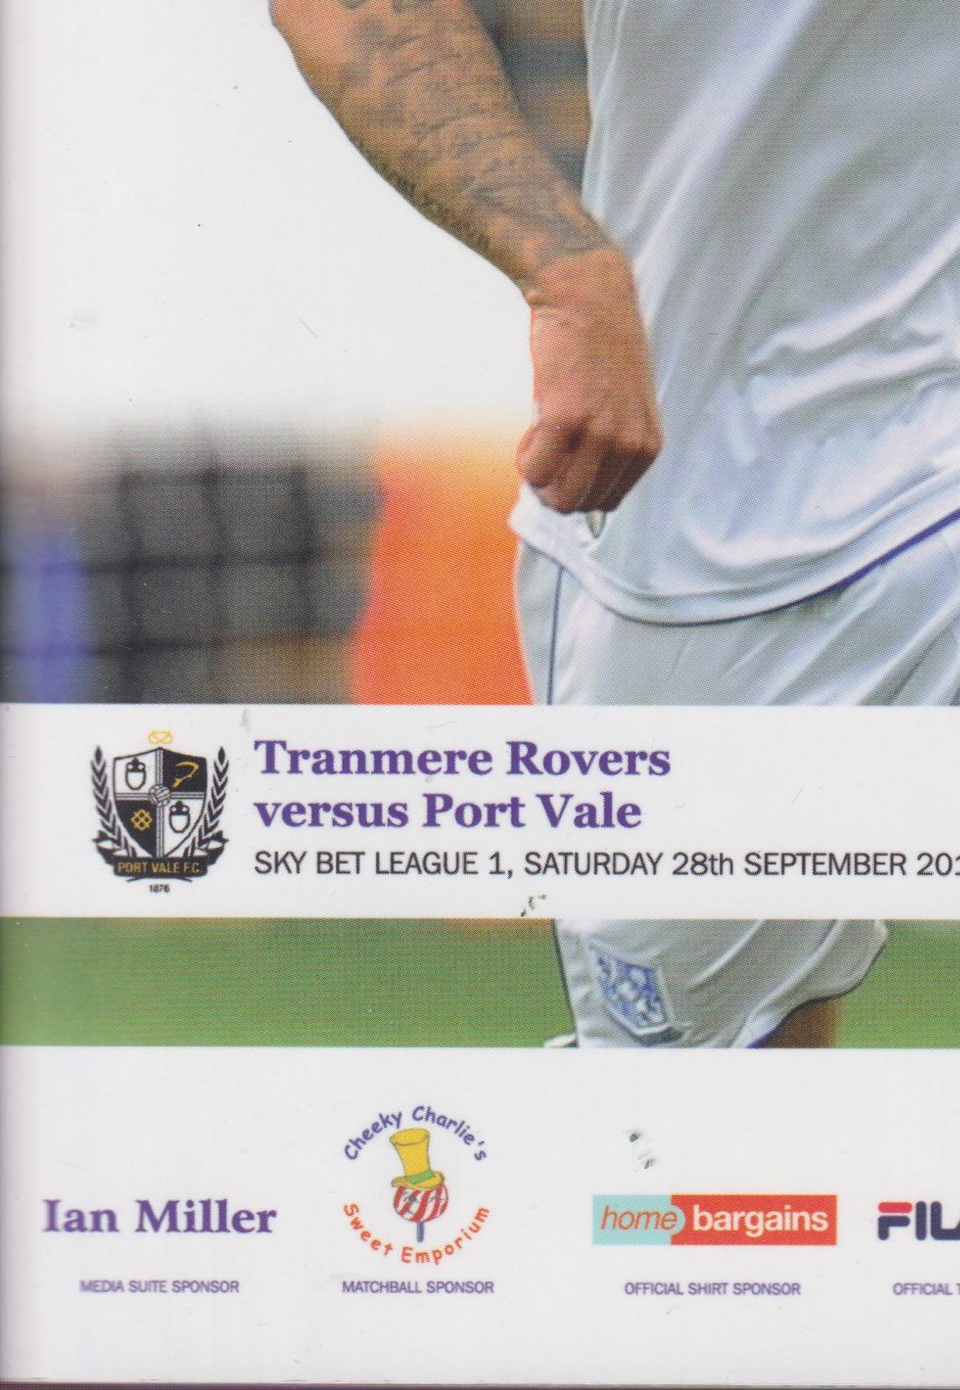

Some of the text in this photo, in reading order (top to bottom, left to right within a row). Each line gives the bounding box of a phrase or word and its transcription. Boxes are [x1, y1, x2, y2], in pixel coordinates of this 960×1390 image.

[254, 740, 670, 776] Tranmere Rovers
[253, 791, 641, 828] versus Port Vale
[118, 862, 149, 873] PORT
[152, 862, 180, 873] VALE
[255, 850, 307, 875] SKY
[316, 851, 366, 874] BET
[376, 851, 478, 875] LEAGUE
[489, 851, 513, 879] 1,
[524, 851, 663, 876] SATURDAY
[672, 851, 734, 876] 28th
[744, 852, 907, 876] SEPTEMBER
[344, 1105, 487, 1161] Cheeky Charlie's
[43, 1199, 277, 1234] Ian Miller
[600, 1204, 829, 1238] home bargains
[344, 1204, 490, 1265] Sweet Emporium
[79, 1280, 239, 1293] MEDIA SUITE SPONSOR
[342, 1281, 494, 1294] MATCHBALL SPONSOR
[624, 1282, 800, 1295] OFFICIAL SHIRT SPONSOR
[893, 1283, 952, 1296] OFFICIAL
